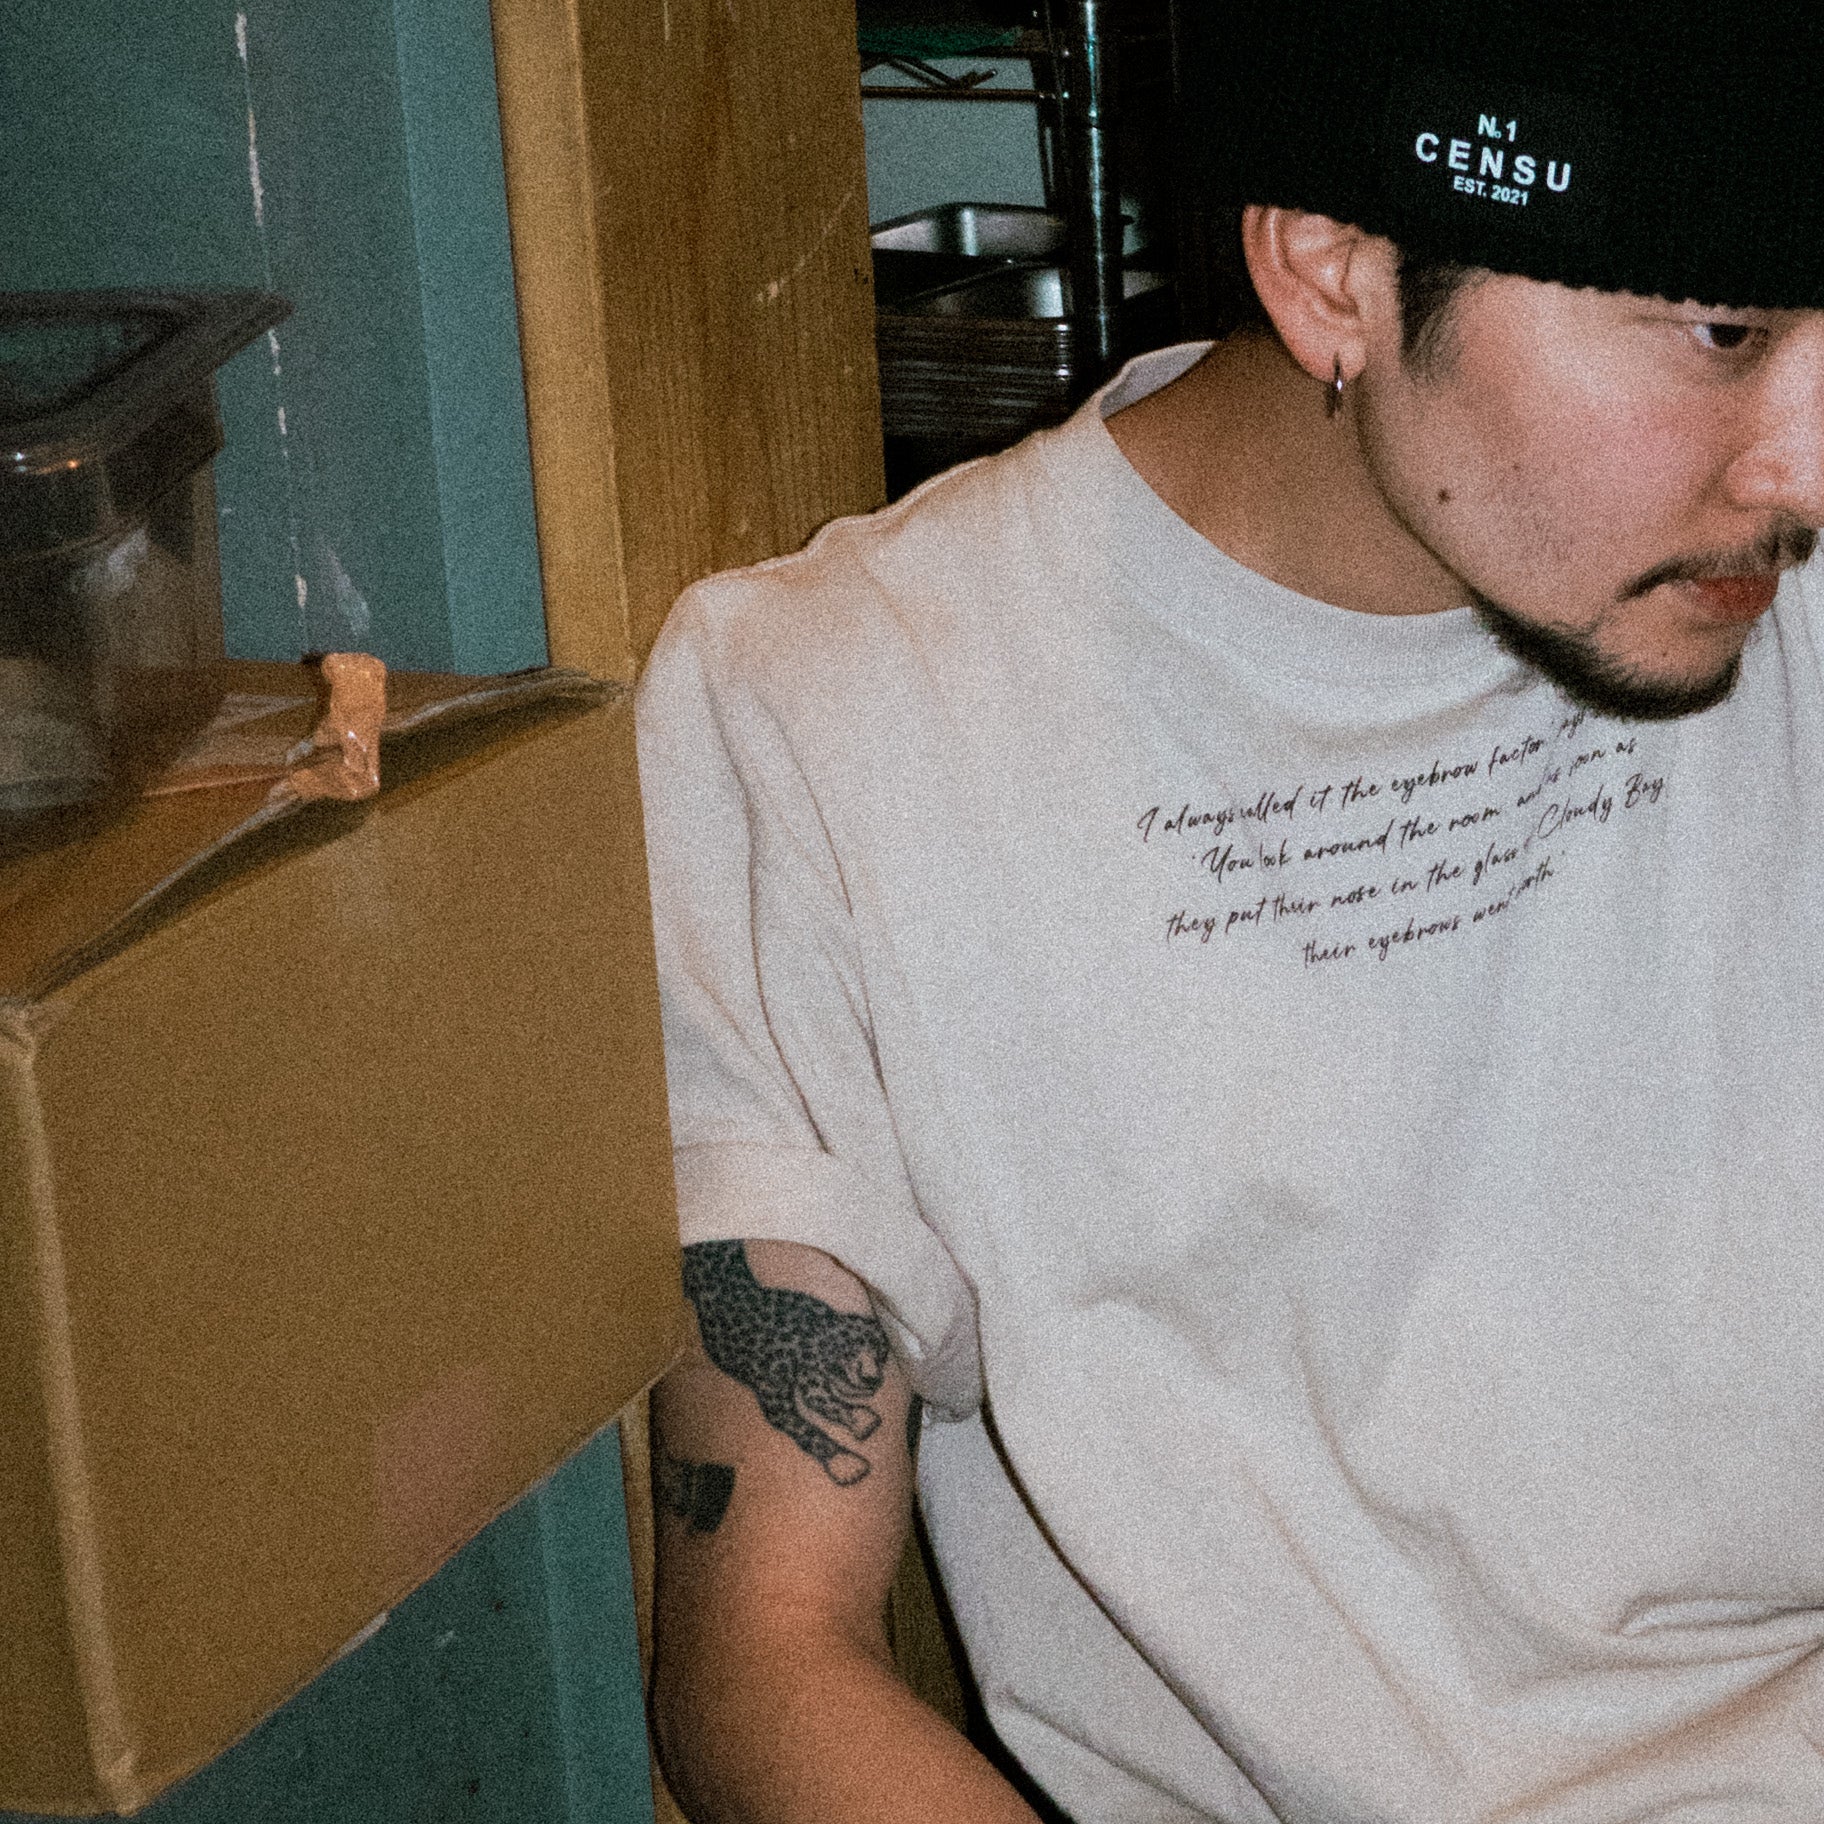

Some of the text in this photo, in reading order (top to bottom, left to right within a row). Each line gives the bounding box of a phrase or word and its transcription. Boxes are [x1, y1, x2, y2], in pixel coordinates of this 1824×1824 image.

[1414, 132, 1572, 192] CENSU
[1453, 175, 1529, 207] EST. 2021
[1137, 806, 1160, 843] I
[1164, 803, 1236, 837] always
[1310, 784, 1333, 813] it
[1341, 775, 1382, 811] the
[1391, 759, 1479, 805] eyebrow
[1487, 734, 1545, 779] factor
[1201, 844, 1254, 884] You
[1303, 818, 1395, 861] around
[1400, 814, 1440, 850] the
[1448, 805, 1501, 832] room
[1615, 736, 1636, 755] as
[1165, 910, 1216, 945] they
[1225, 895, 1267, 934] put
[1330, 884, 1382, 910] nose
[1391, 876, 1420, 897] in
[1426, 858, 1464, 893] the
[1537, 783, 1613, 840] Cloudy
[1624, 773, 1665, 811] Bay
[1302, 939, 1357, 971] their
[1368, 916, 1462, 962] eyebrows
